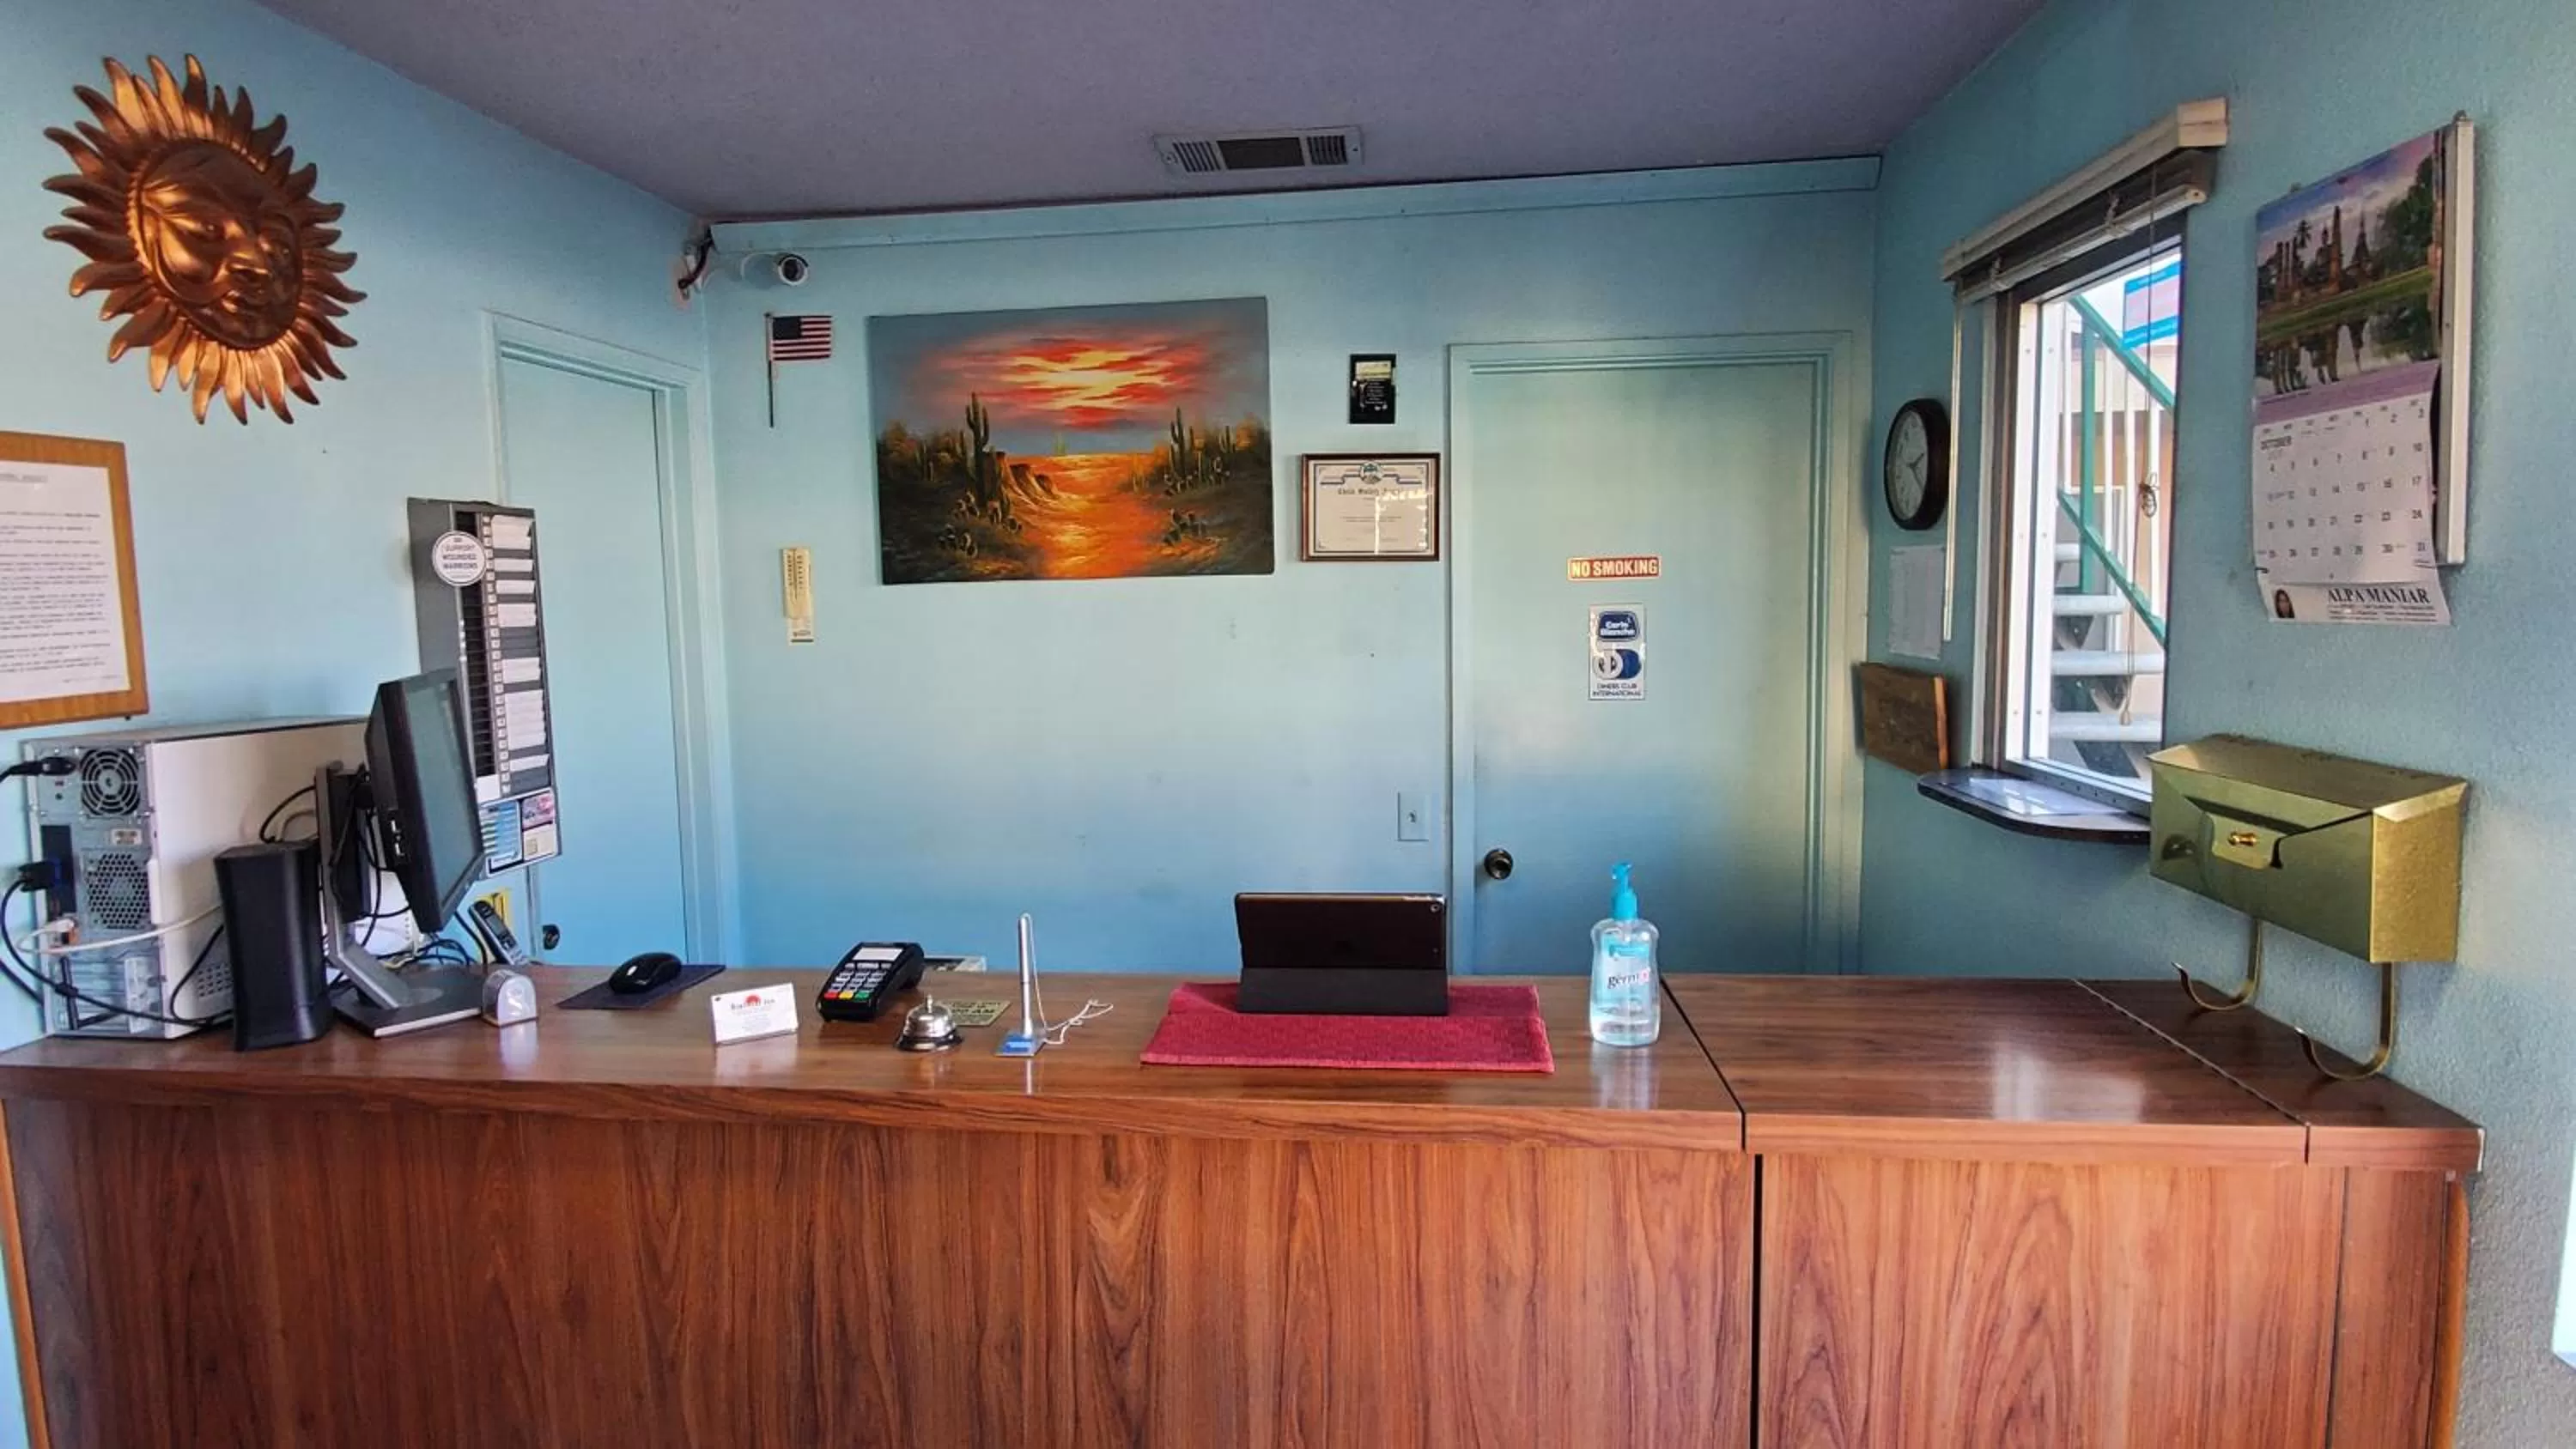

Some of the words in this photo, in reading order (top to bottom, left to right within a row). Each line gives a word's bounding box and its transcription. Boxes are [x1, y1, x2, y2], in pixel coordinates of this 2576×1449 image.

[1571, 561, 1590, 577] NO
[1593, 559, 1658, 576] SMOKING
[2328, 587, 2365, 603] ALPA
[2366, 587, 2430, 603] MANIAR
